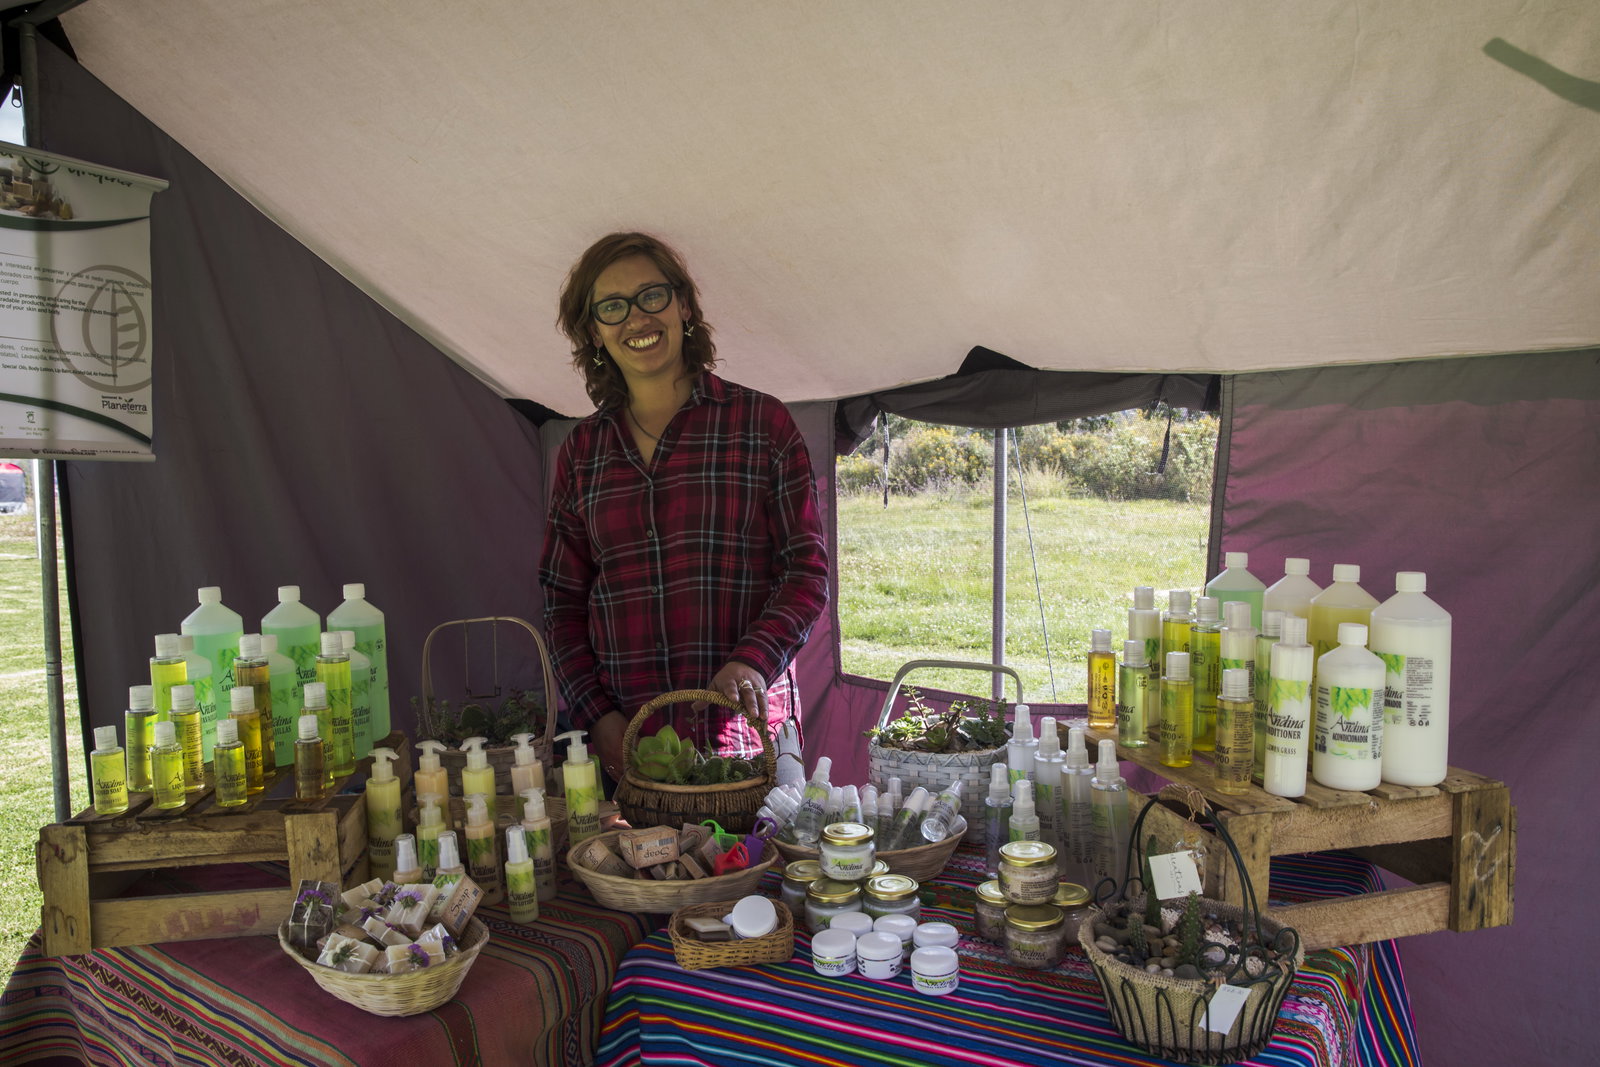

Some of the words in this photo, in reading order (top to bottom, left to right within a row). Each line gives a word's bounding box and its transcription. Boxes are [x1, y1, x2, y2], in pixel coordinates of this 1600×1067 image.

[102, 400, 147, 412] Planeterra
[1385, 686, 1404, 700] dina
[1330, 714, 1371, 733] Andina
[1266, 726, 1302, 740] NDITIONER
[1281, 746, 1297, 755] GRASS
[450, 888, 470, 917] Soap
